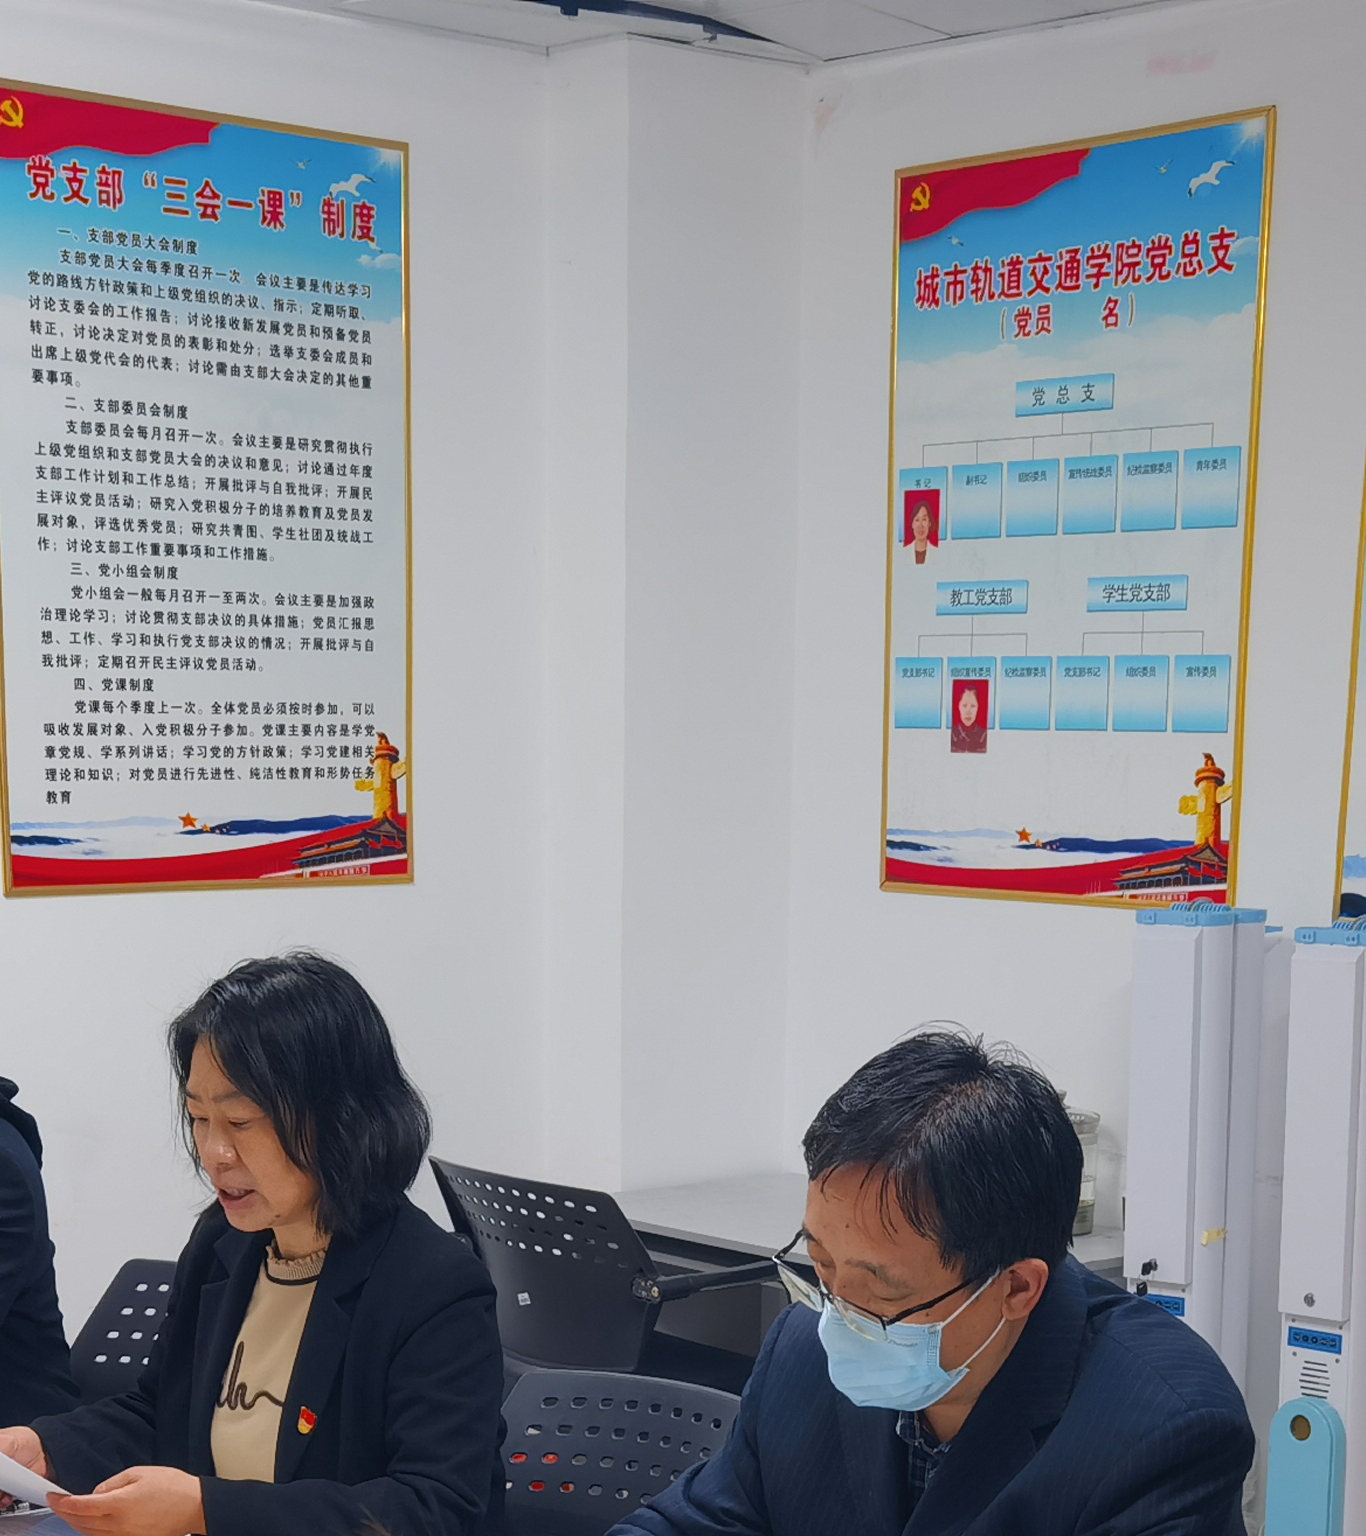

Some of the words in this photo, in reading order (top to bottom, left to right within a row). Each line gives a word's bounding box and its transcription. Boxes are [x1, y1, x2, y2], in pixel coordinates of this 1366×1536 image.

[25, 155, 378, 243] 党支部“三会一课”制度
[914, 226, 1239, 310] 城市轨道交通学院党总支
[1031, 382, 1096, 408] 党总支
[949, 587, 1013, 608] 教工党支部
[1102, 582, 1172, 604] 学生党支部
